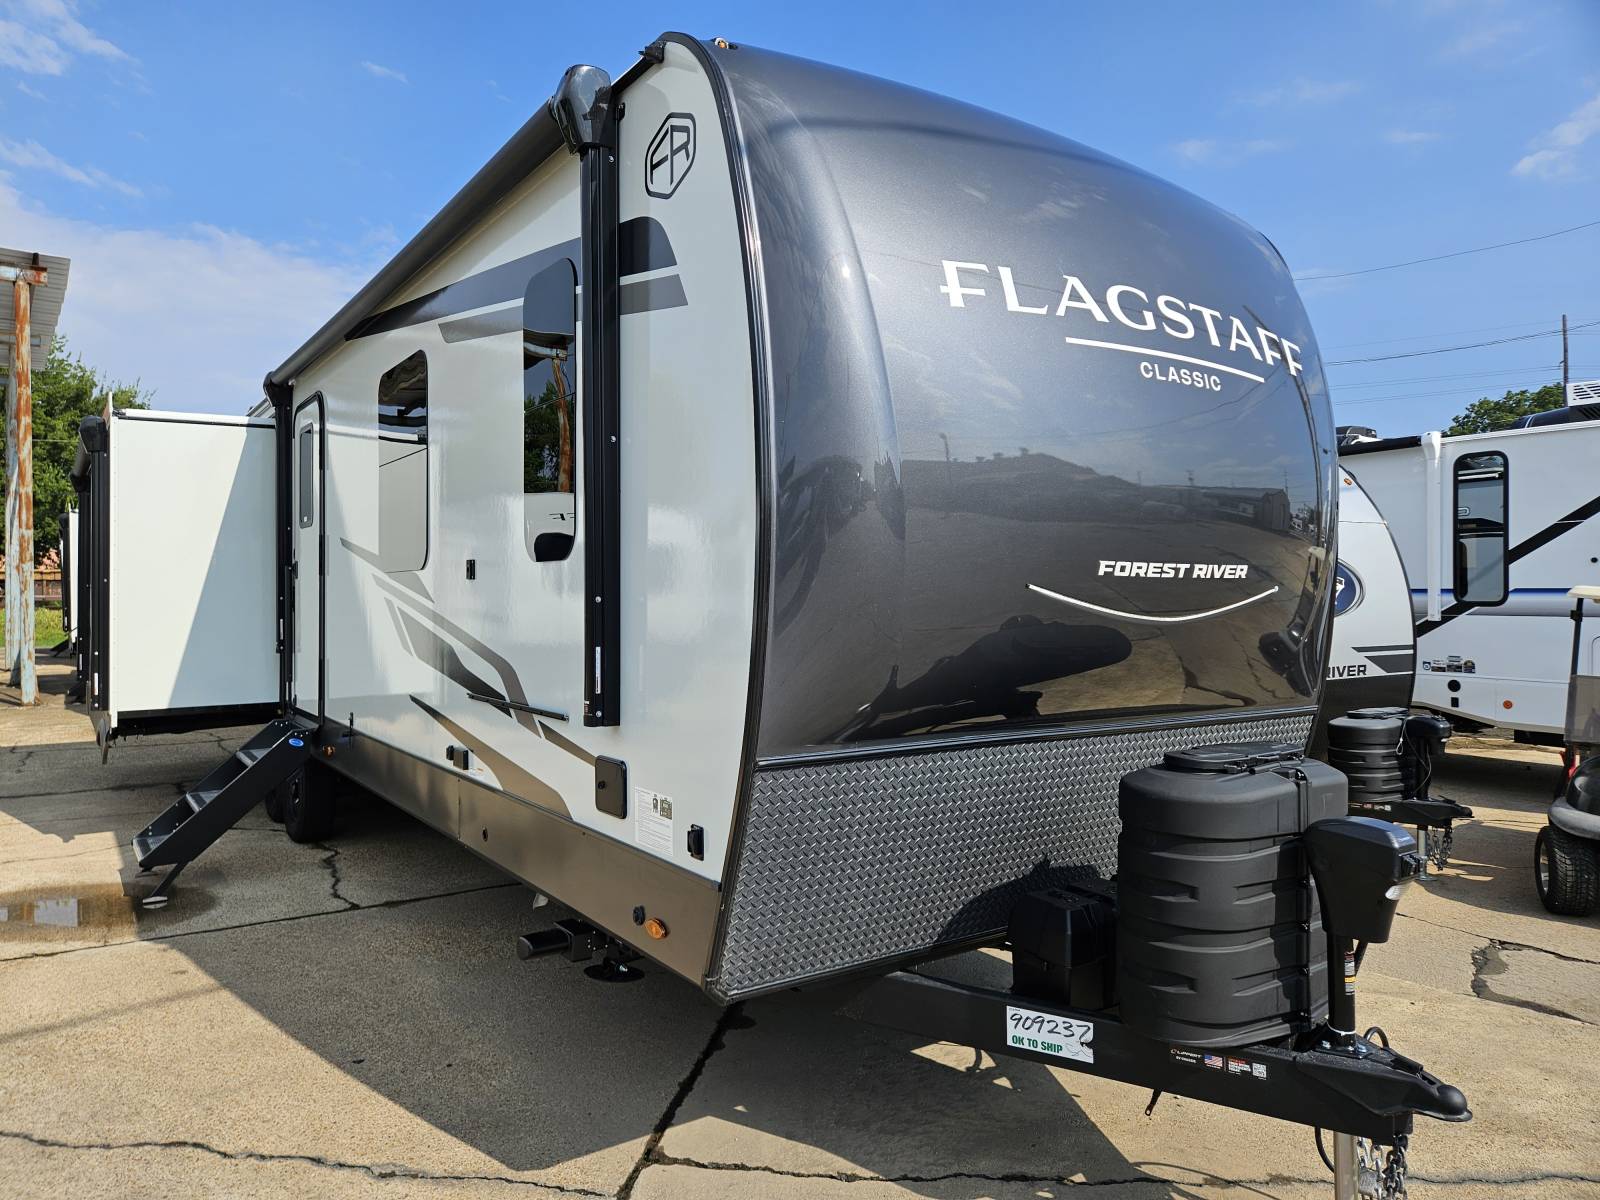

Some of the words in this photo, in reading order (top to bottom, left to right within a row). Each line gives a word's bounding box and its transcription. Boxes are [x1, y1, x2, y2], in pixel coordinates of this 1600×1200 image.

[939, 259, 1303, 377] FLAGSTAFF
[1140, 361, 1222, 392] CLASSIC
[1098, 560, 1191, 579] FOREST
[1192, 563, 1249, 579] RIVER
[1010, 1013, 1091, 1041] 909237
[1011, 1034, 1025, 1046] OK
[1027, 1038, 1038, 1049] TO
[1040, 1040, 1063, 1054] SHIP
